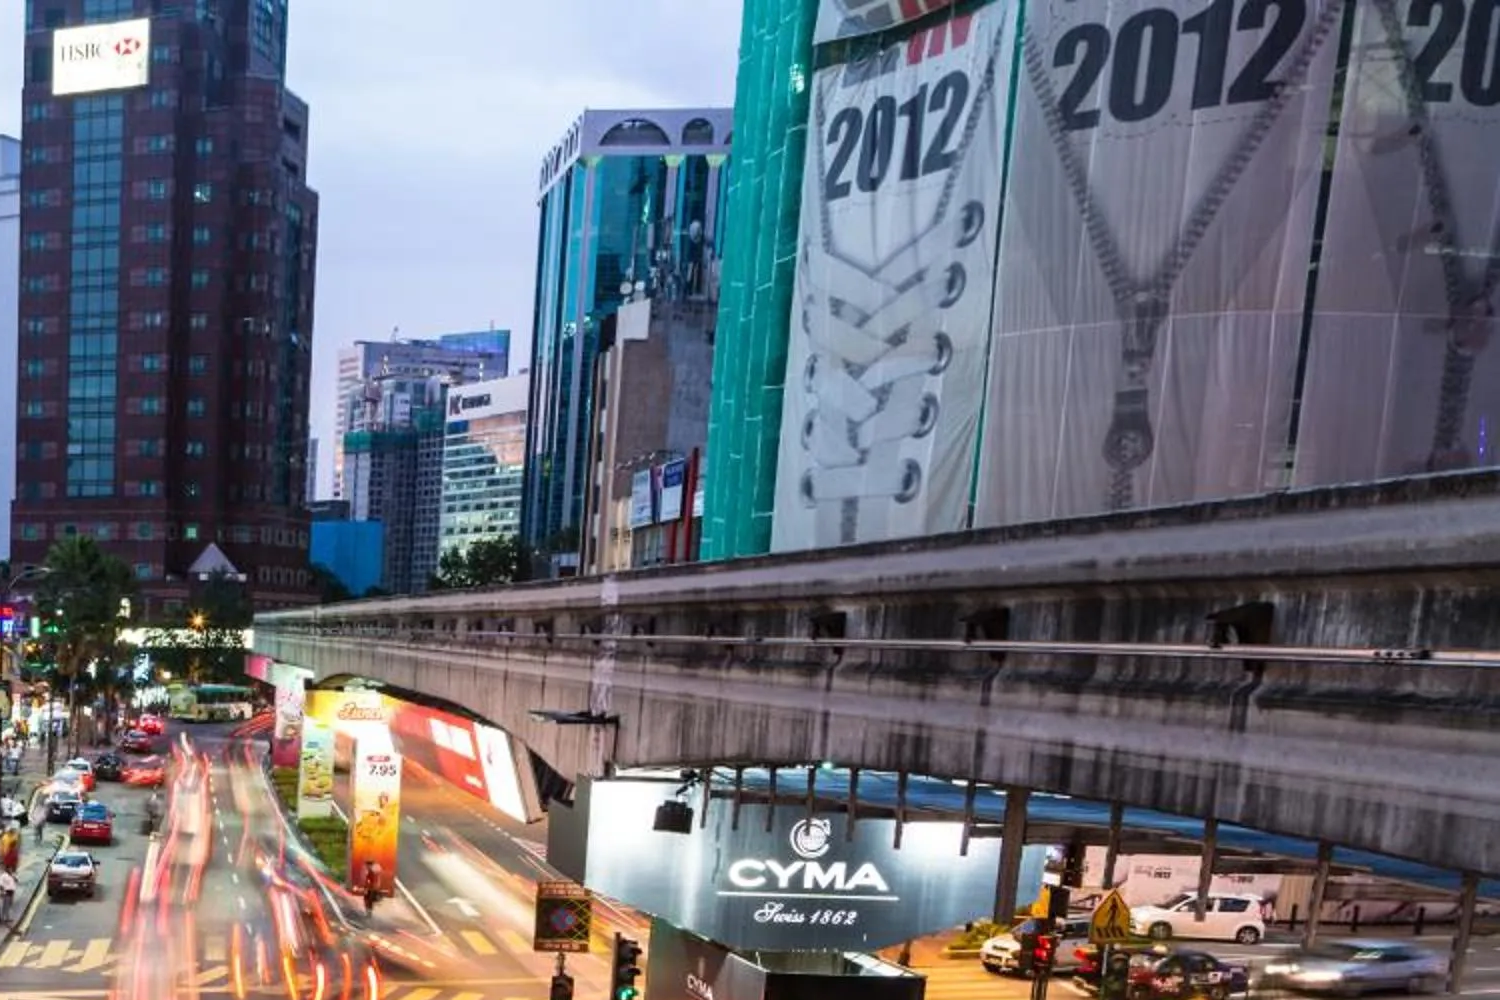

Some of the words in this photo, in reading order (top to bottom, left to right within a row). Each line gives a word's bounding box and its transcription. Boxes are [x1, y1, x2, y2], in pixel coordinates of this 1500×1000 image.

[1053, 0, 1306, 130] 2012
[825, 69, 970, 201] 2012
[728, 858, 890, 892] CYMA
[754, 902, 805, 924] Swiss
[810, 908, 858, 926] 1862
